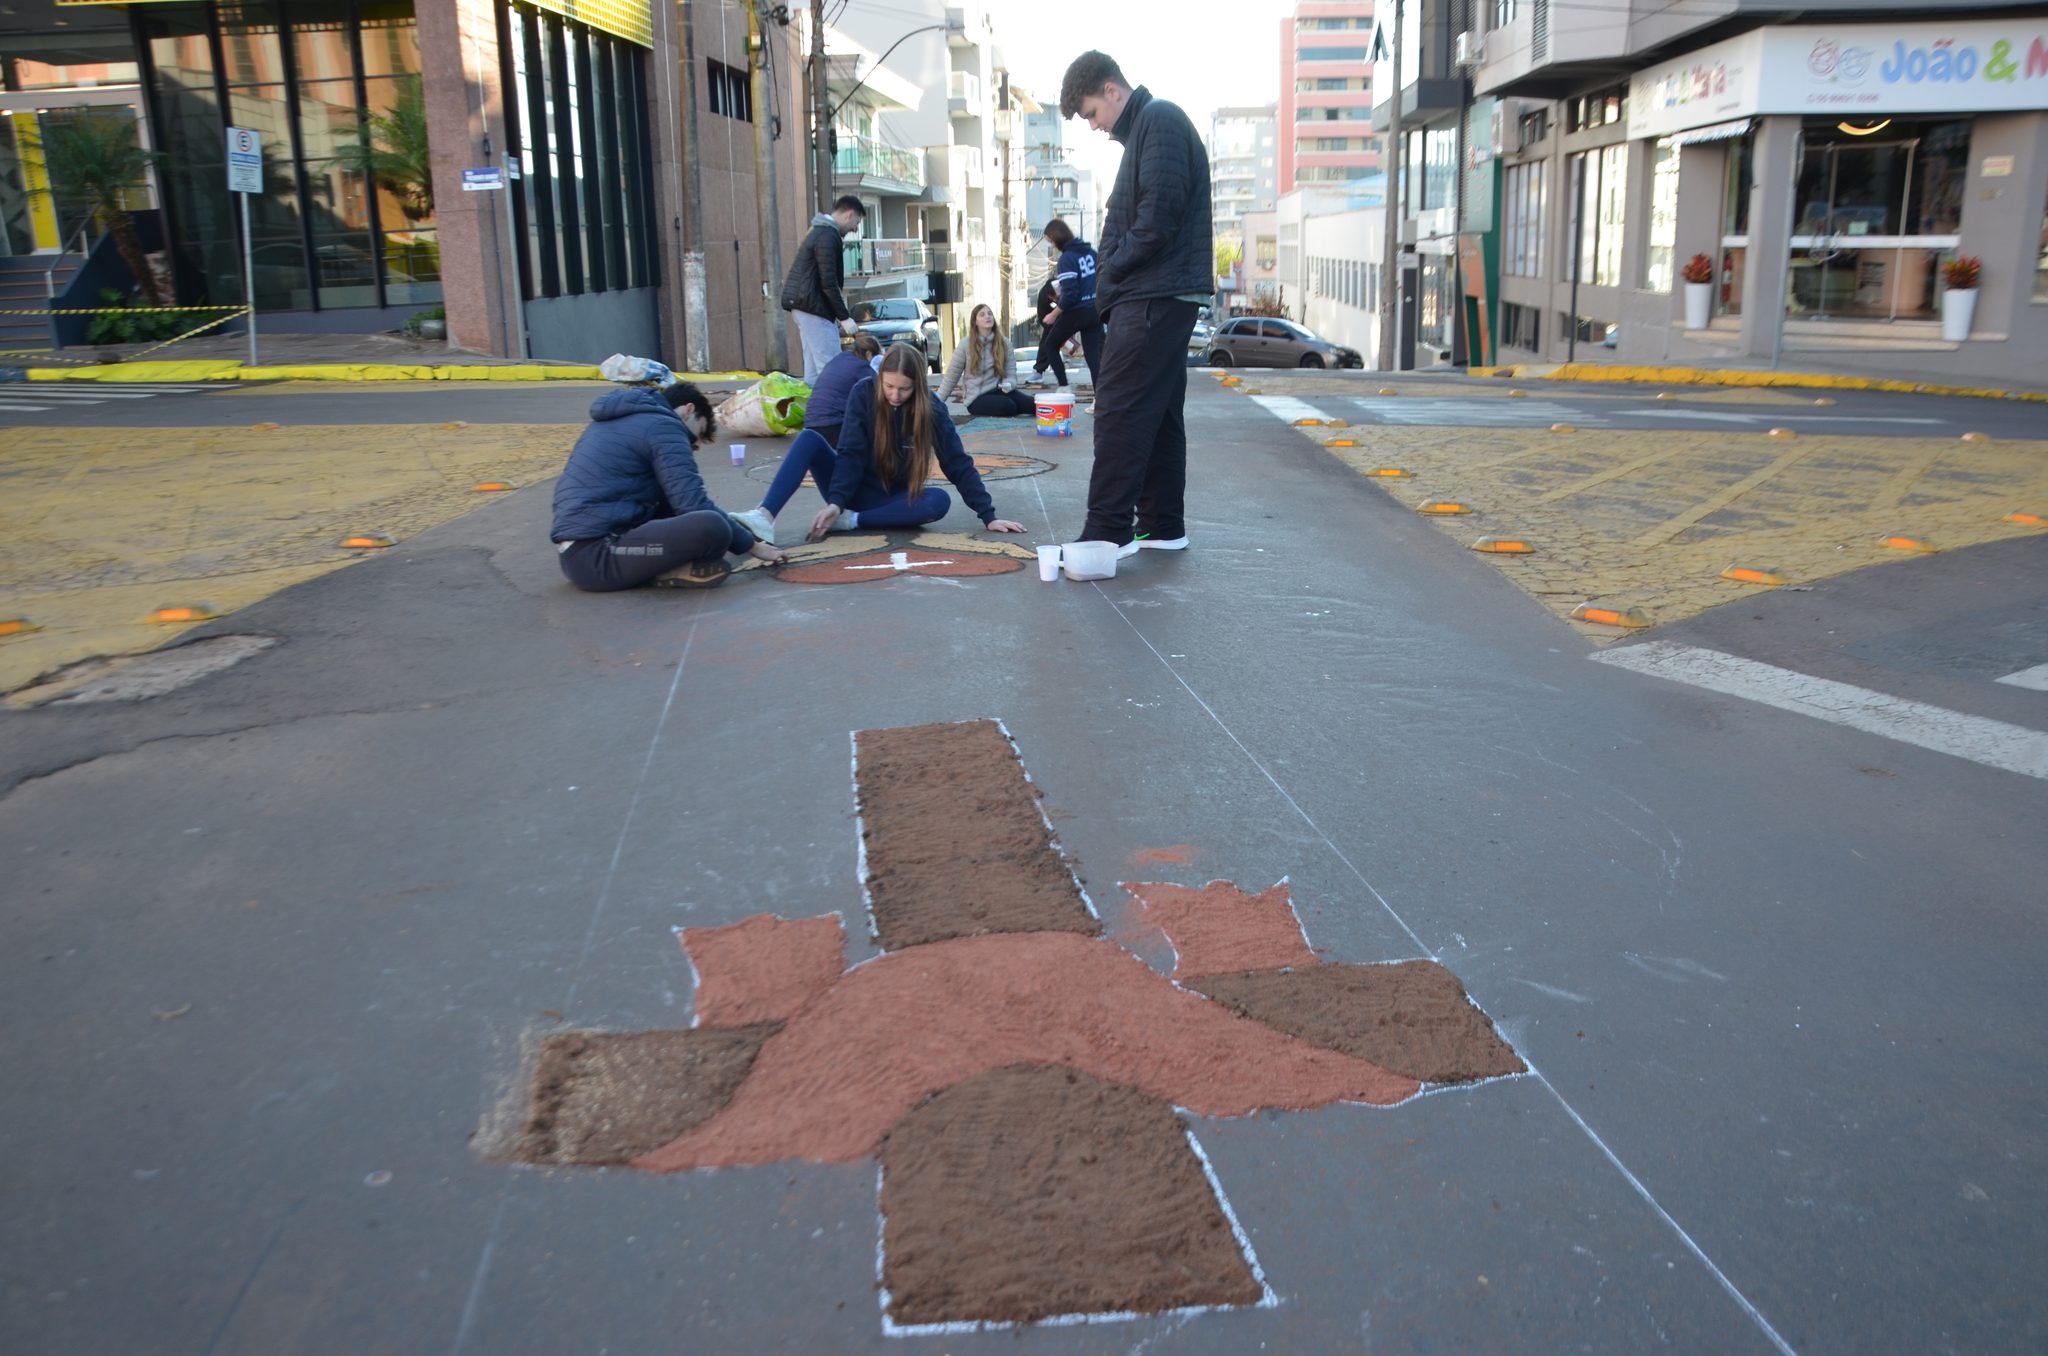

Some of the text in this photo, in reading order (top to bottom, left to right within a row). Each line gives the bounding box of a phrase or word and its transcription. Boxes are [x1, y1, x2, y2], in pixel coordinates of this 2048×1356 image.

[1881, 38, 1979, 84] João
[1984, 37, 2019, 83] &
[1078, 253, 1096, 278] 92
